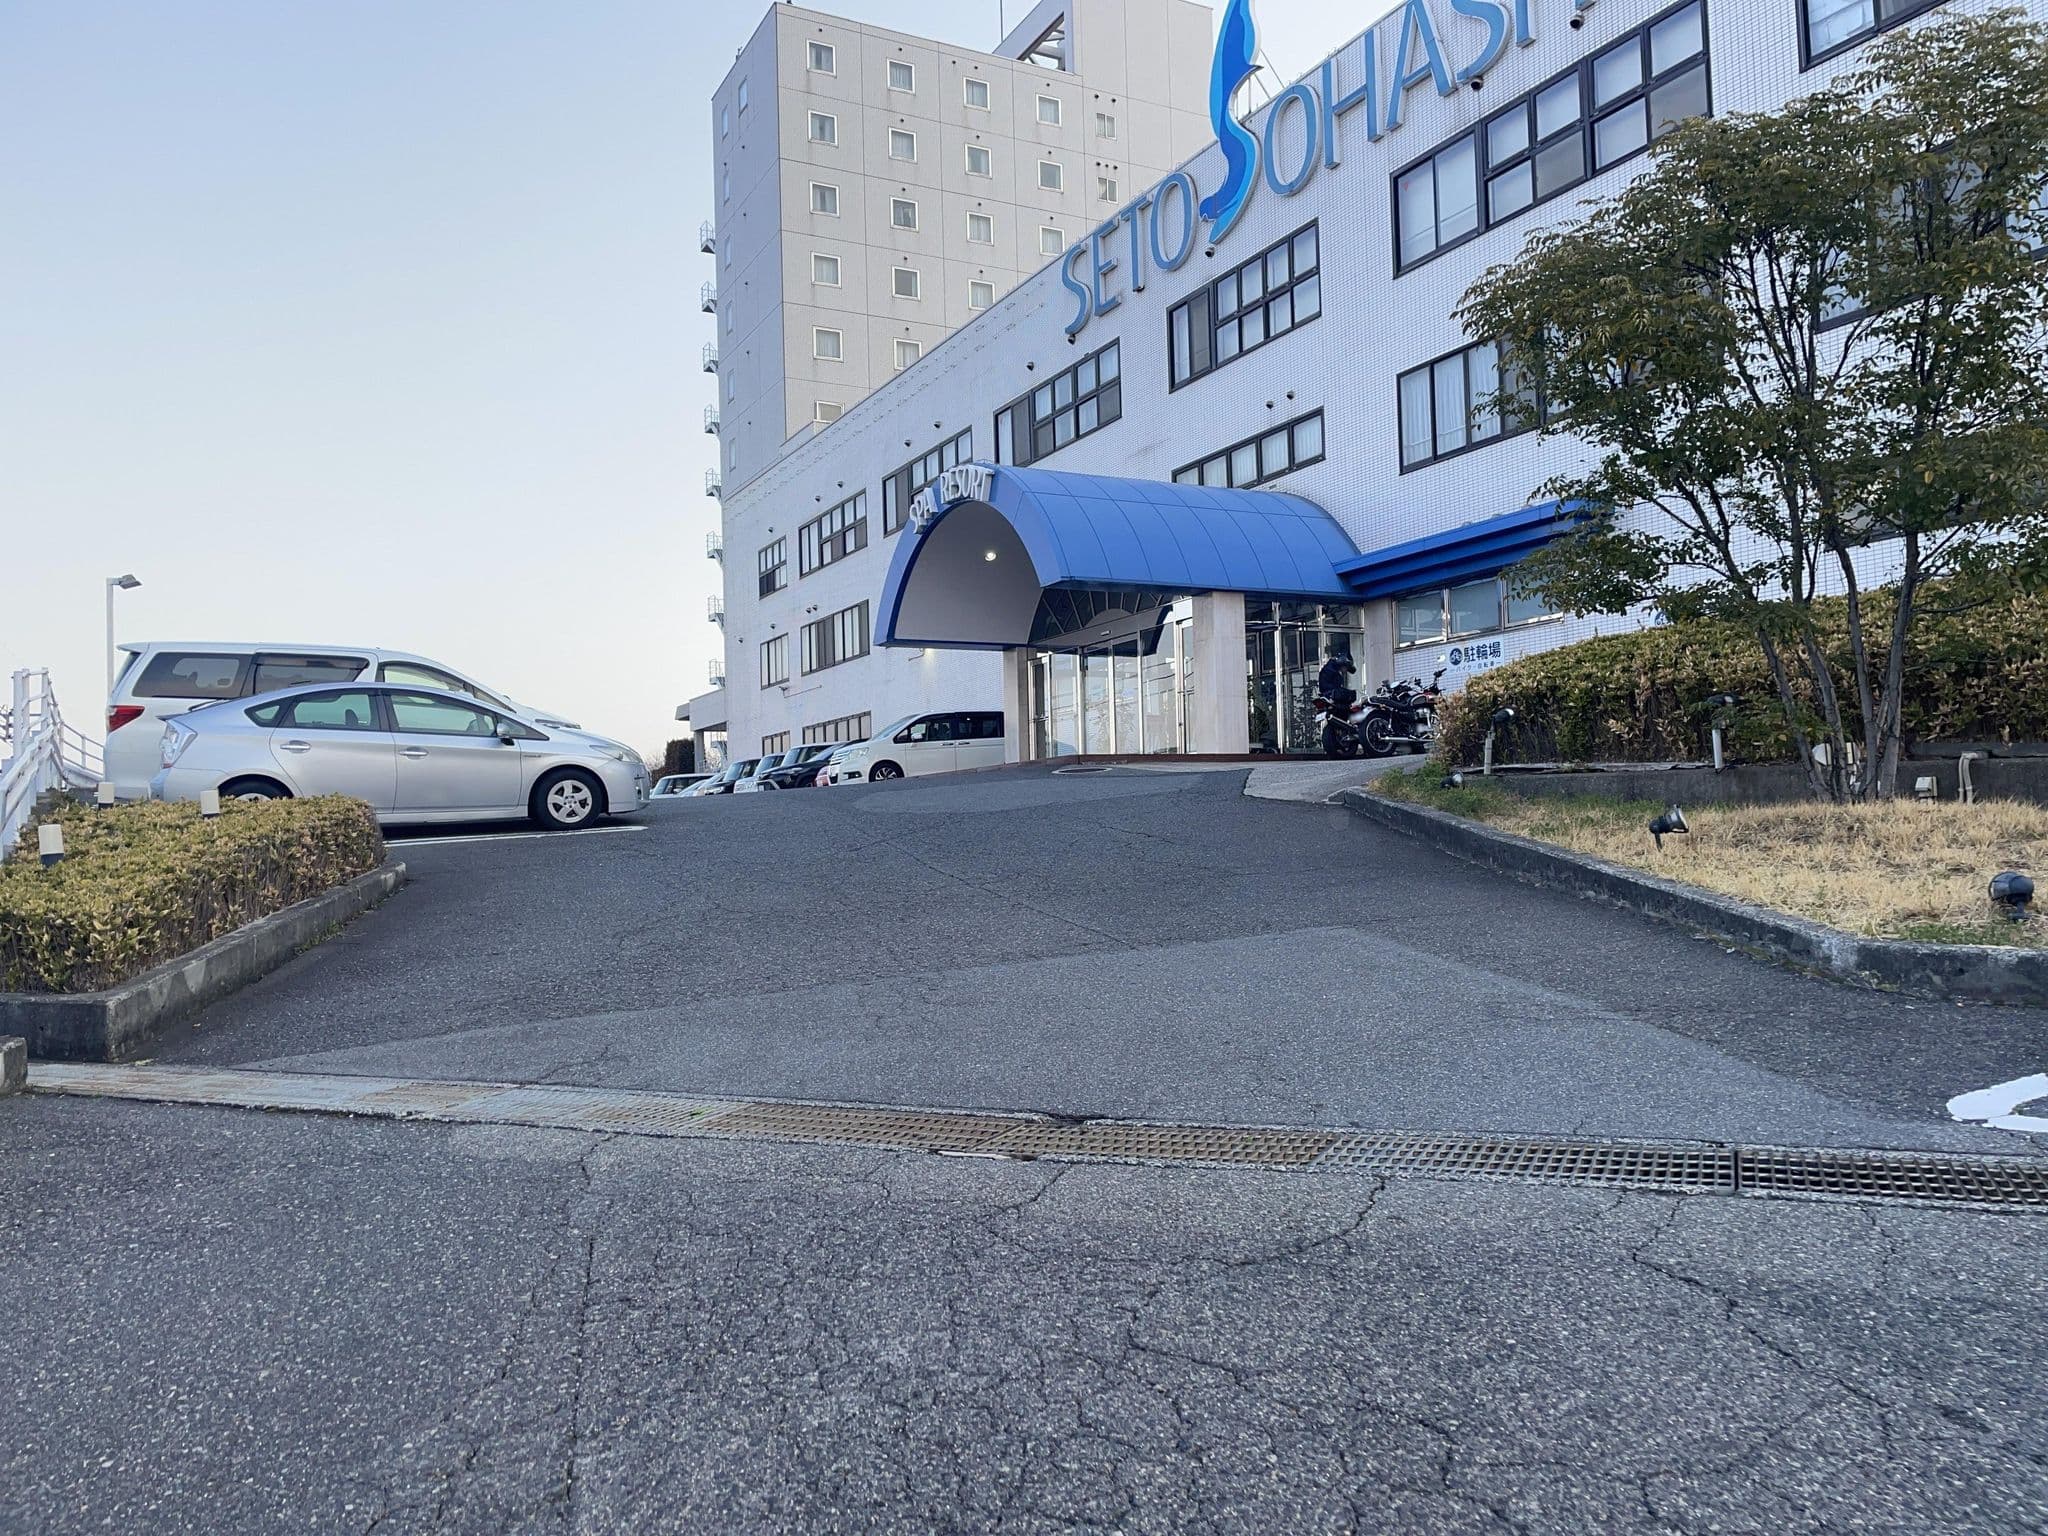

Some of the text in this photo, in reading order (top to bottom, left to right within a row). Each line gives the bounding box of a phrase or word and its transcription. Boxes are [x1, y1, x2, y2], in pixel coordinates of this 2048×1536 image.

[1062, 172, 1199, 335] SETO
[909, 464, 995, 535] SPA RESORT
[1463, 641, 1501, 663] 駐輪場
